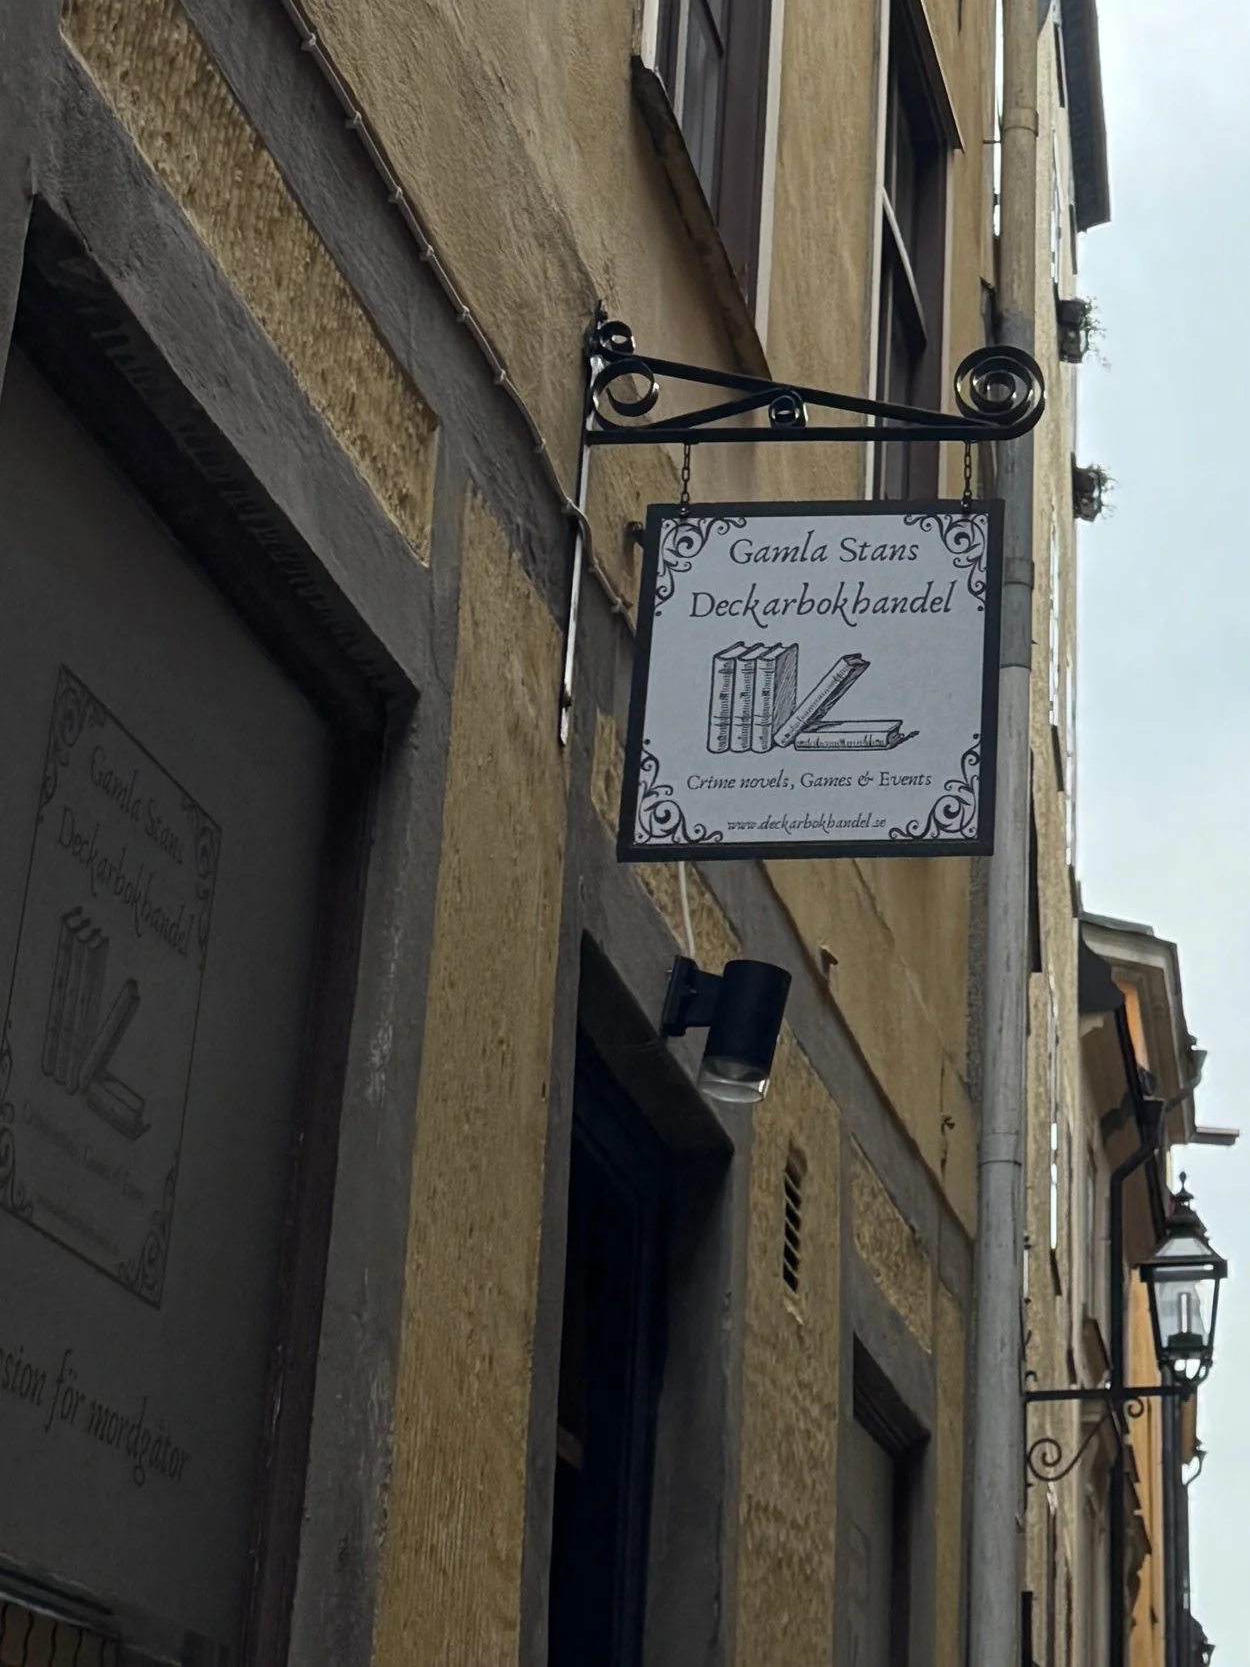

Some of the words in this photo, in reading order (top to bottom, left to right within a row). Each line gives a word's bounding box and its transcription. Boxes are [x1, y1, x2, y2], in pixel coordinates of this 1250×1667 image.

[729, 530, 828, 565] Gamla
[838, 536, 919, 563] Stans
[688, 580, 957, 629] Deckarbokhandel
[90, 744, 141, 822] Gamla
[686, 774, 736, 790] Crime
[740, 768, 795, 790] novels,
[800, 772, 852, 788] Games
[857, 771, 873, 786] &
[879, 771, 932, 786] Events
[727, 812, 886, 834] www.deckarbokhandel.se
[58, 805, 193, 959] Deckarbokhandel
[44, 1348, 85, 1433] för
[87, 1396, 190, 1487] mordgåtor
